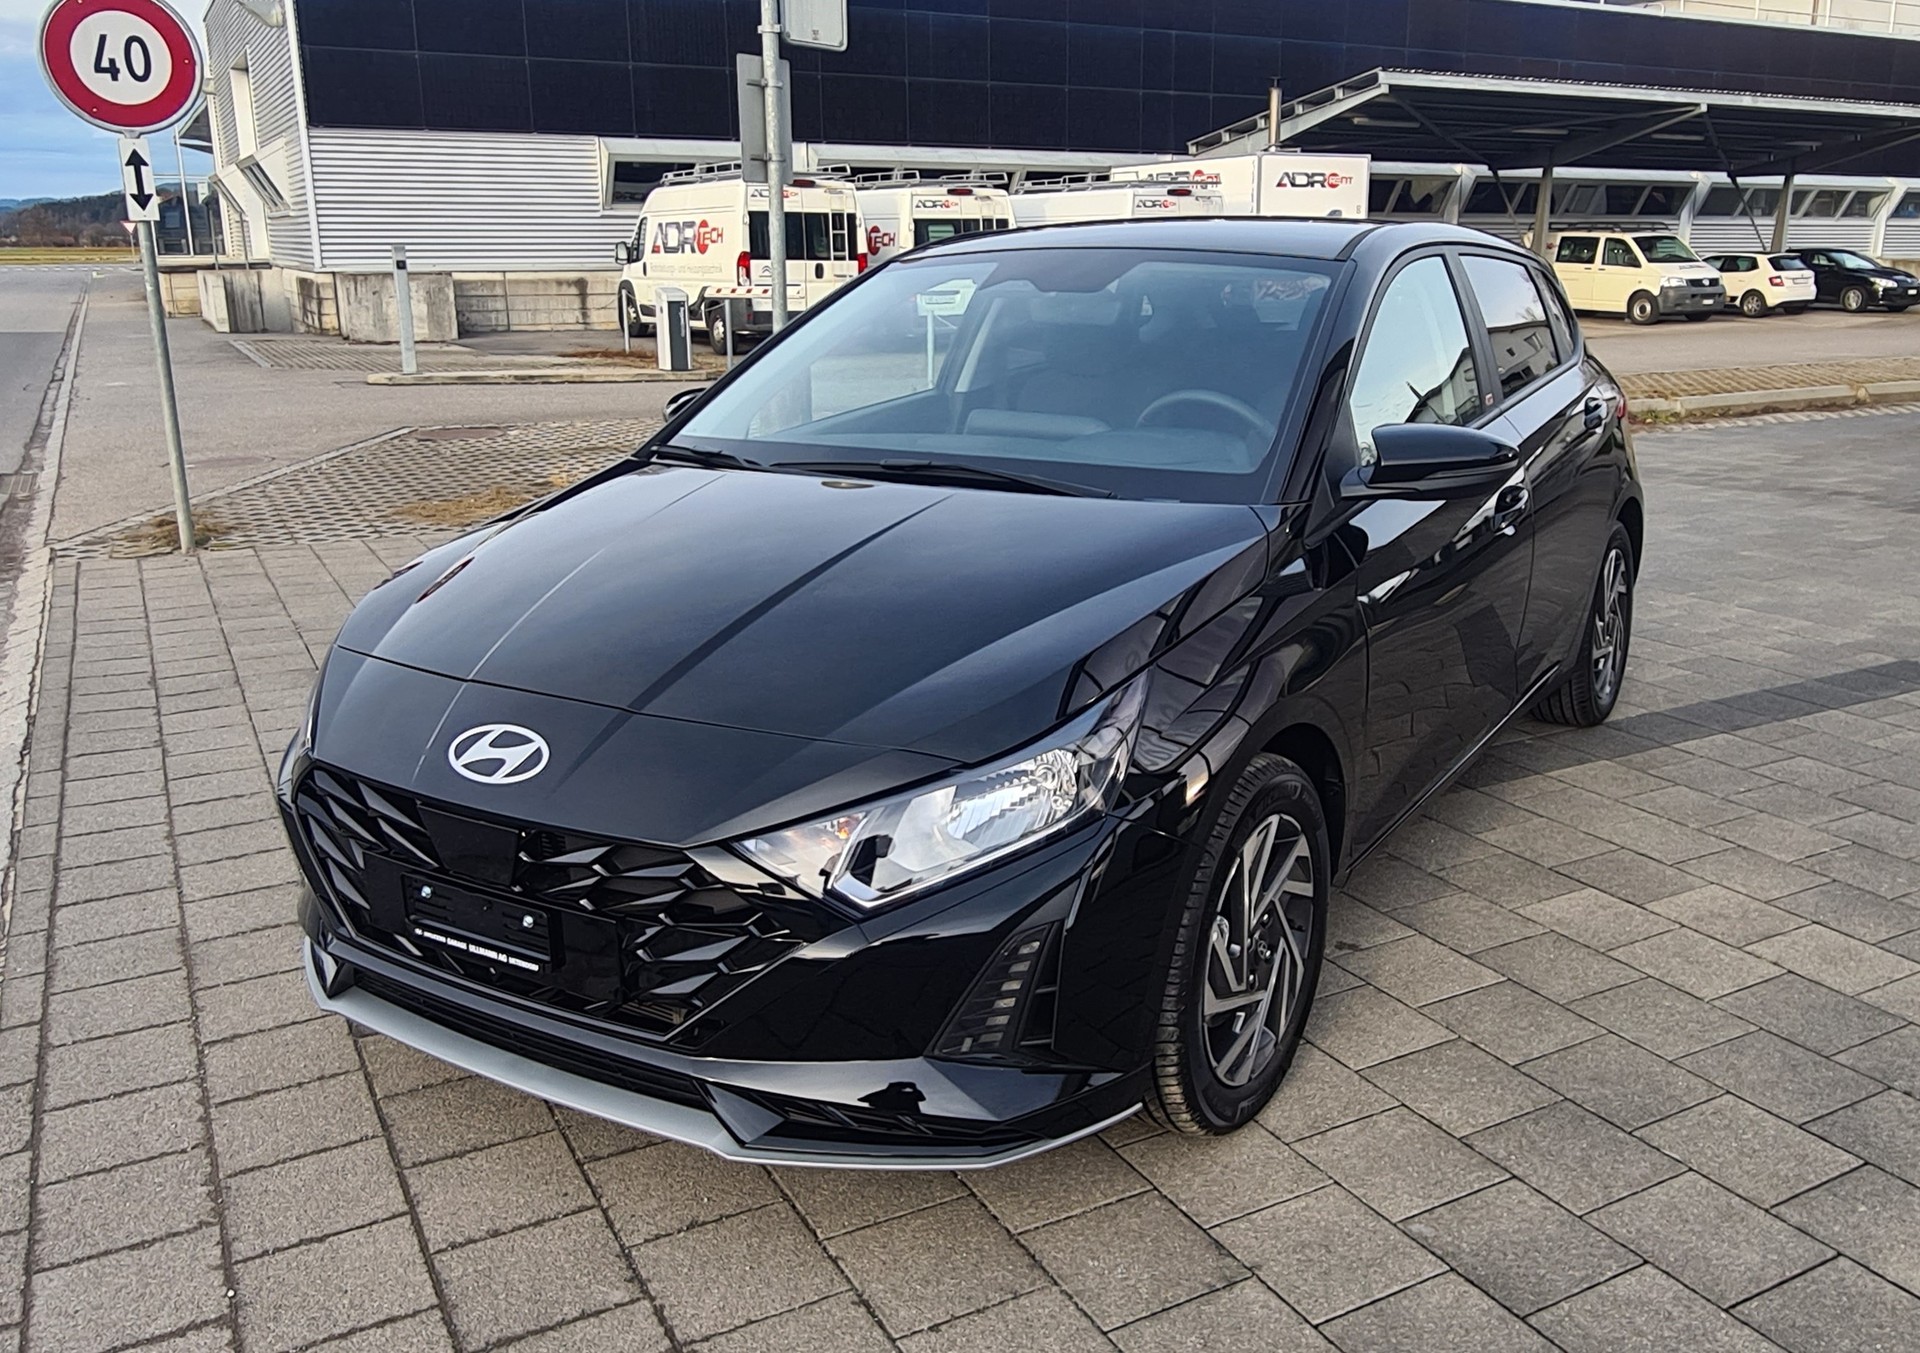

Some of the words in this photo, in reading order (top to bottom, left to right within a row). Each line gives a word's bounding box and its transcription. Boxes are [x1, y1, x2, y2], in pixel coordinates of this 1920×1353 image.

[94, 34, 152, 82] 40
[1276, 171, 1327, 188] ADR
[651, 221, 697, 254] ADR
